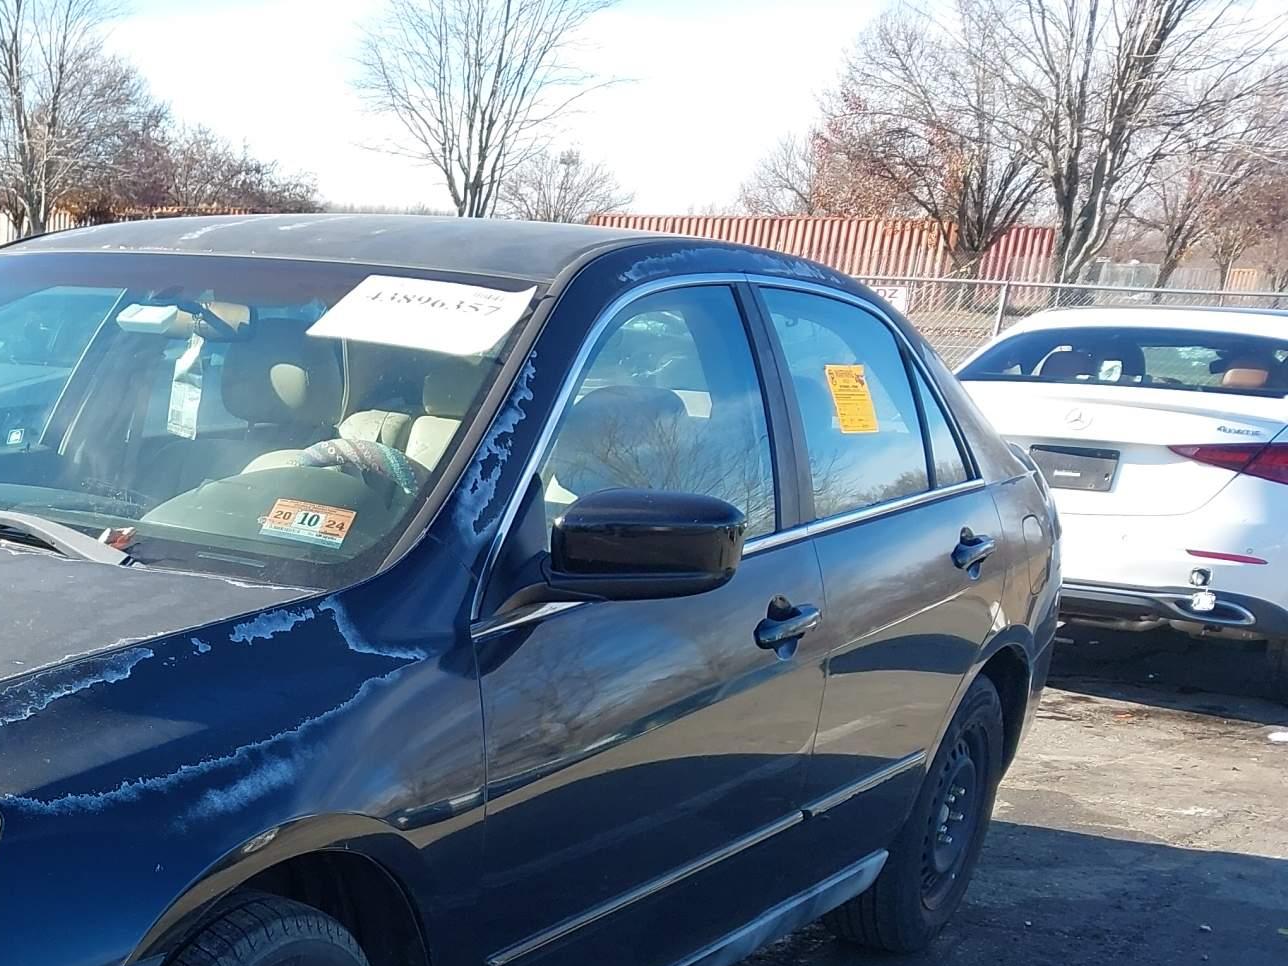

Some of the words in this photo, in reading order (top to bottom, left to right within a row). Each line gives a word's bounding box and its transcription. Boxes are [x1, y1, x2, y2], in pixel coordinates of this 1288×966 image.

[274, 510, 292, 521] 20
[298, 512, 321, 527] 10
[325, 519, 345, 531] 24
